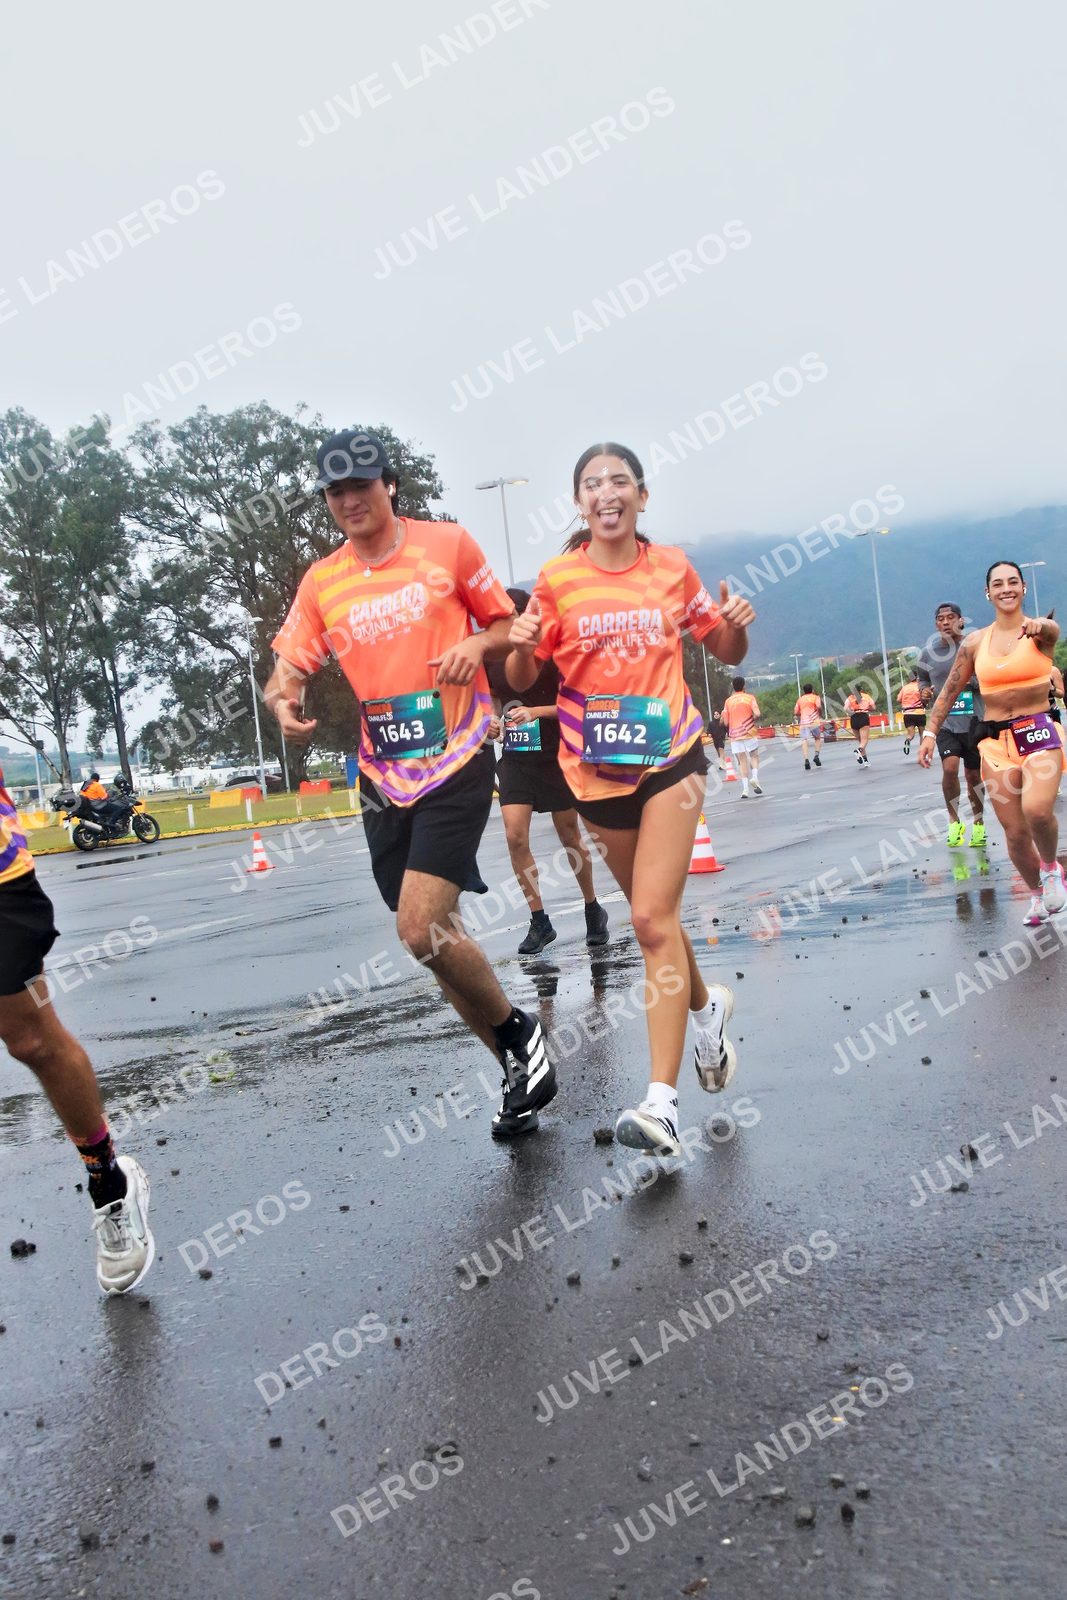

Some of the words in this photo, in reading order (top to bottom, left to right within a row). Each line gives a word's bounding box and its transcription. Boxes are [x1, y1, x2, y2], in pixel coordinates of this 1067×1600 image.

[347, 582, 425, 625] CARRERA
[578, 608, 663, 638] CARRERA
[416, 695, 434, 711] 10K
[646, 701, 663, 717] 10K
[952, 701, 965, 709] 26
[379, 720, 425, 743] 1643
[508, 732, 530, 742] 1273
[593, 723, 647, 744] 1642
[1026, 728, 1051, 744] 660
